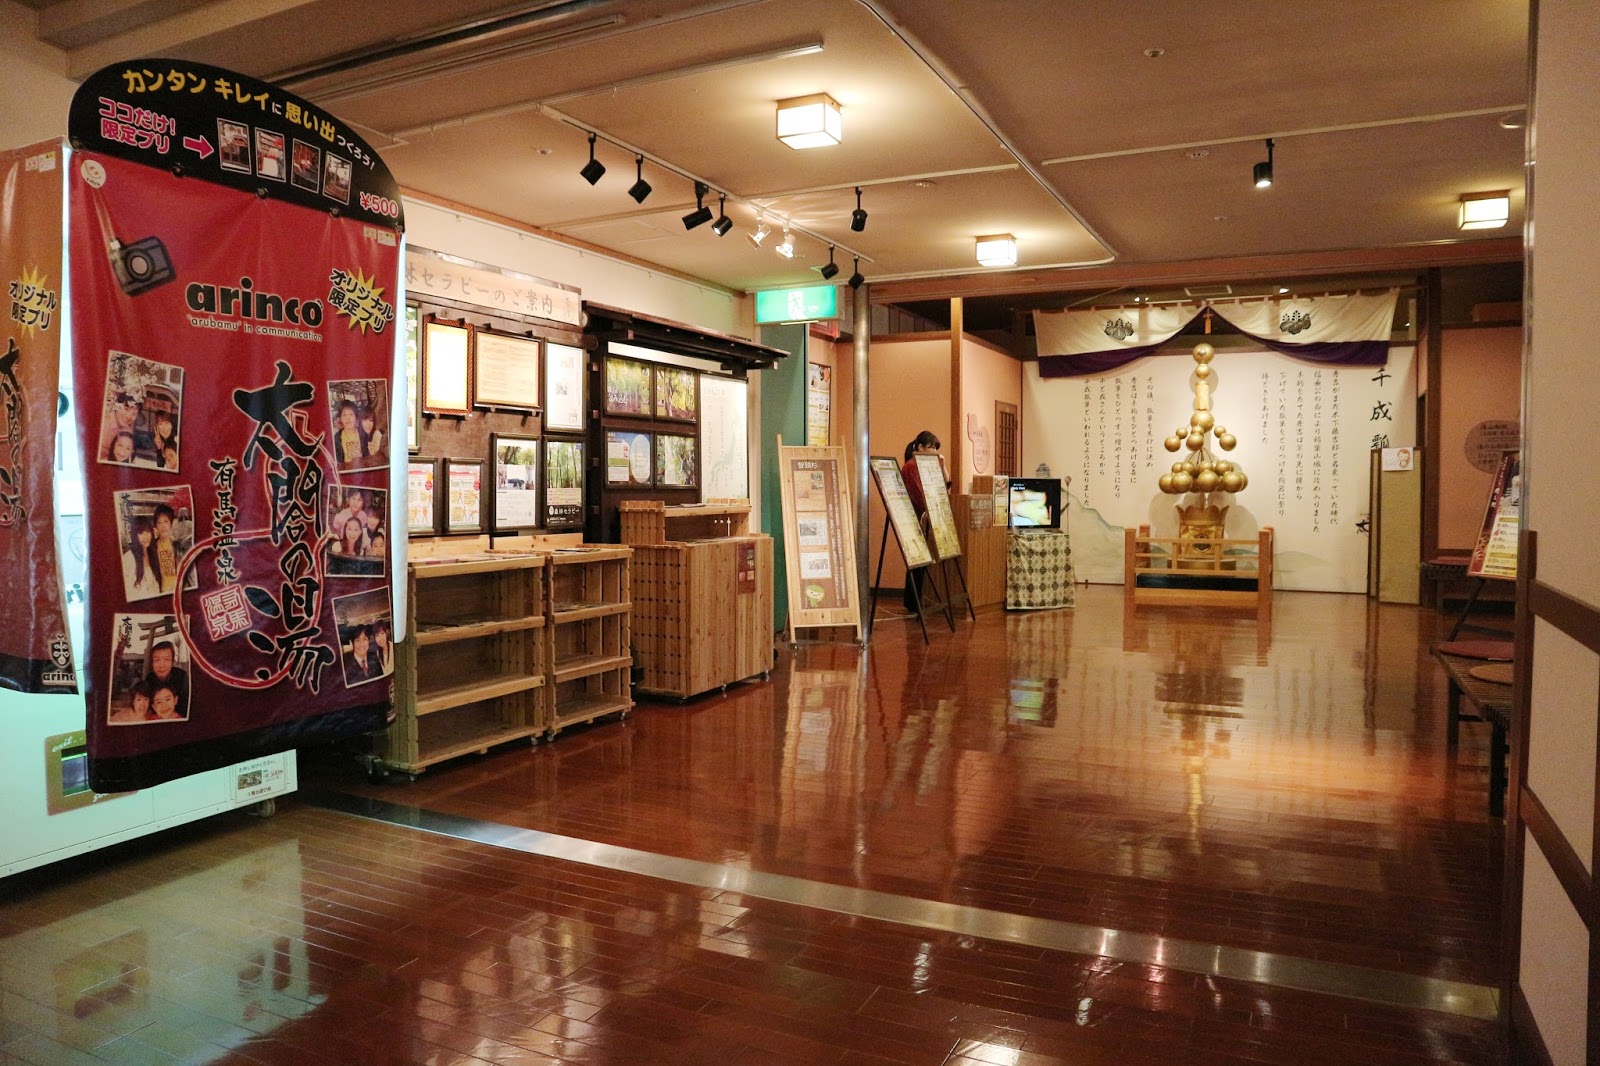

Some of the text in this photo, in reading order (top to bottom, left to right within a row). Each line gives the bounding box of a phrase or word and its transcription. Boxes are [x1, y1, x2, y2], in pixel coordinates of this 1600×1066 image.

[122, 69, 207, 94] カンタン
[98, 97, 176, 136] ココだけ!
[101, 119, 170, 155] 限定プリ
[359, 191, 398, 218] ¥500
[9, 280, 57, 312] オリジナル
[186, 277, 323, 327] arinco
[328, 286, 386, 333] 限定プリ
[330, 268, 394, 321] オリジナル
[11, 303, 51, 331] 限定プリ
[244, 322, 253, 332] in
[256, 326, 323, 342] communication
[210, 458, 239, 584] 有馬温泉
